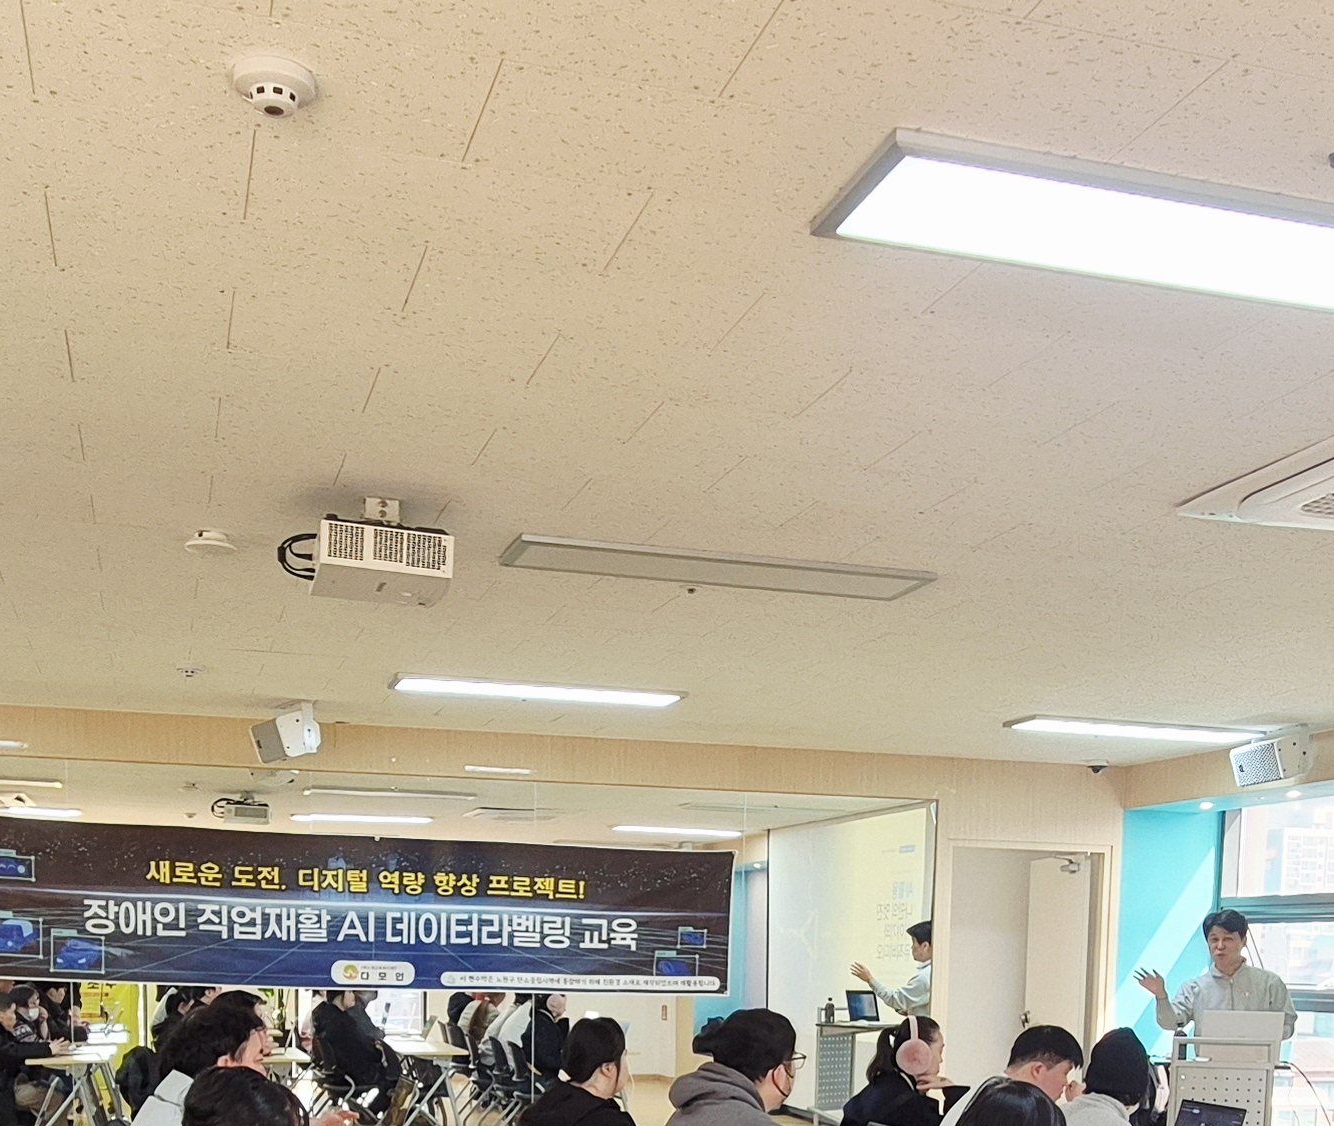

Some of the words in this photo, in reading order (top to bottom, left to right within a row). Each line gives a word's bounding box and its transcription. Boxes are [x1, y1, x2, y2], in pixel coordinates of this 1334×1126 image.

[146, 860, 223, 886] 새로운
[298, 868, 368, 893] 디지털
[378, 871, 425, 895] 역량
[433, 873, 479, 897] 향상
[487, 875, 585, 899] 프로젝트!
[82, 899, 186, 938] 장애인
[196, 904, 331, 943] 직업재활
[337, 911, 375, 943] AI
[385, 912, 571, 950] 데이터라벨링
[579, 918, 638, 951] 교육
